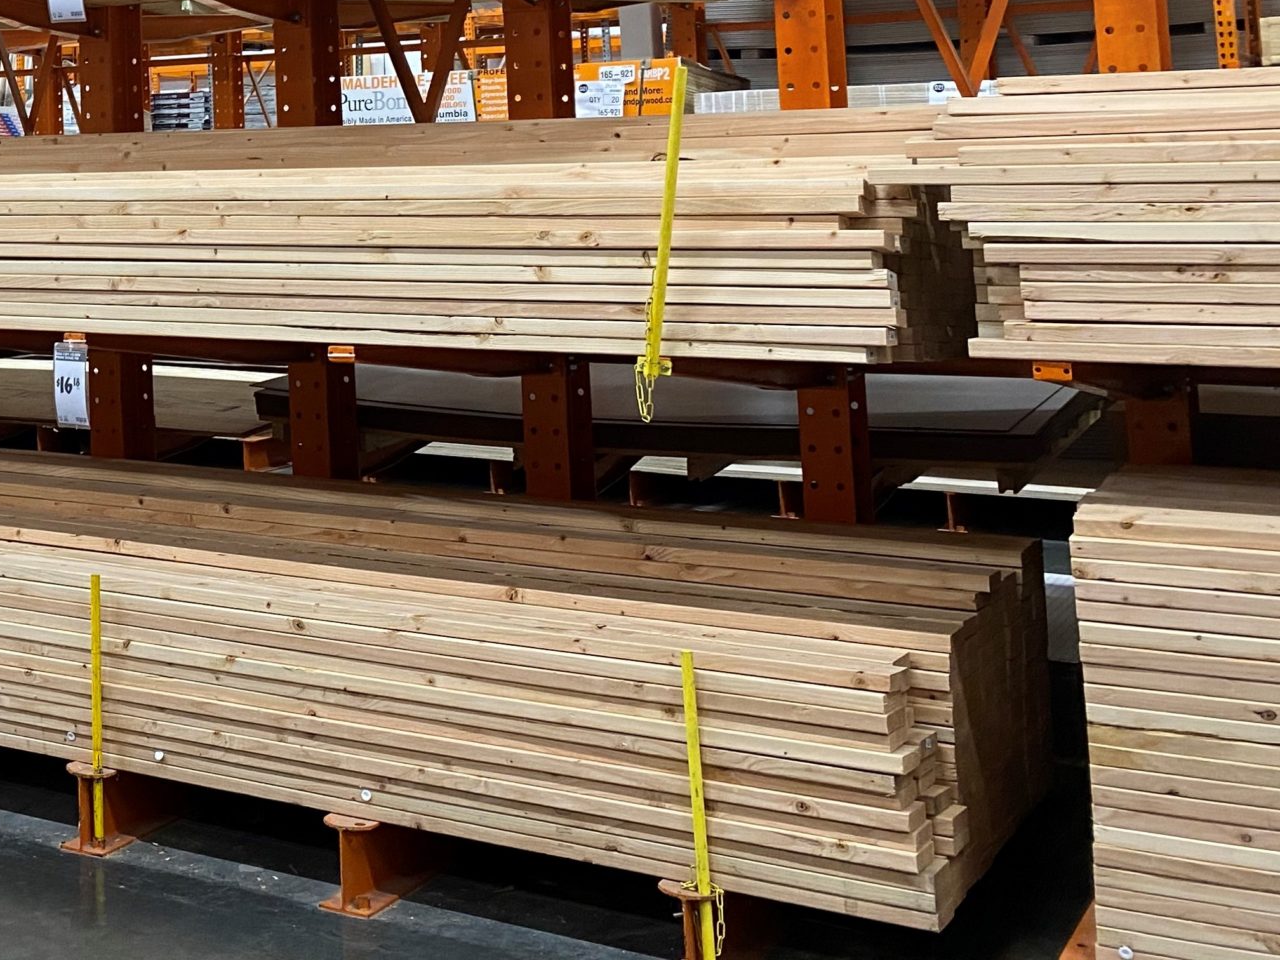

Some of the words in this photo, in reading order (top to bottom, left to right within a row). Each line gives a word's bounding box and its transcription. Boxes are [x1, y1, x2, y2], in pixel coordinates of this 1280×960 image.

[342, 91, 408, 112] PureBon
[439, 109, 468, 118] umbia
[358, 116, 376, 124] Made
[385, 115, 412, 123] America
